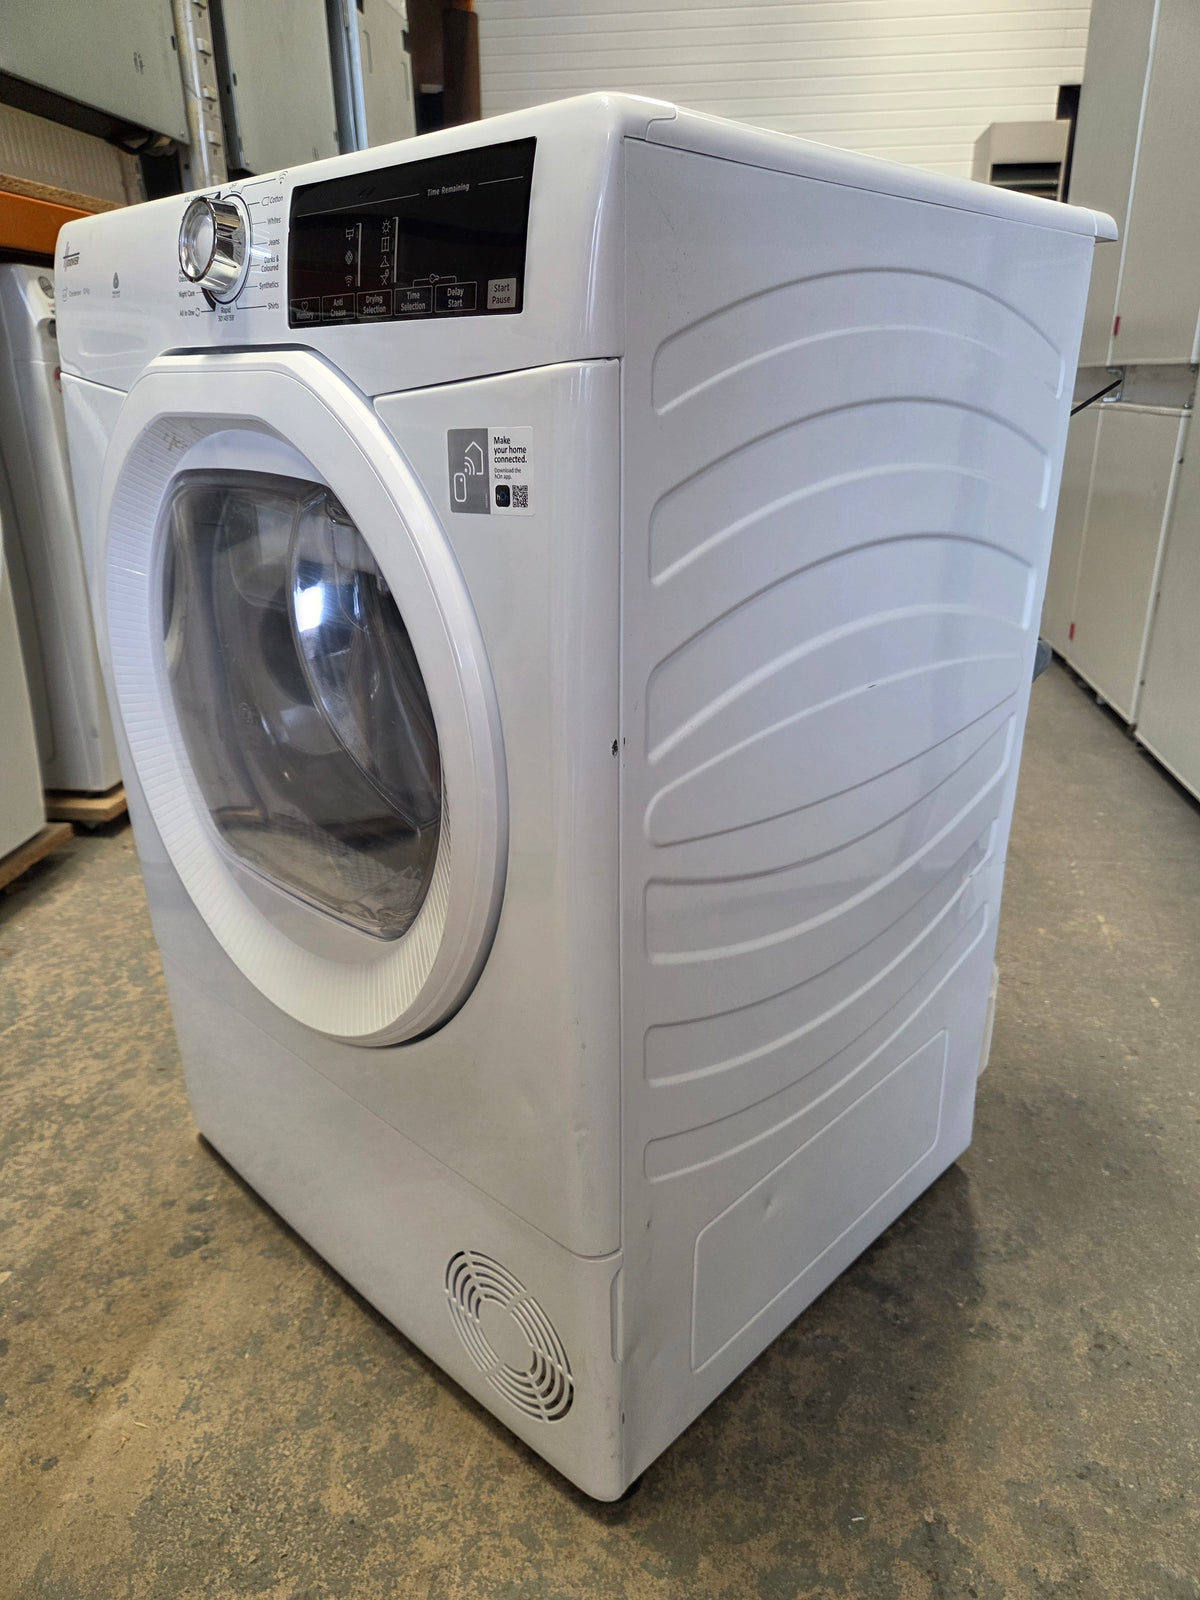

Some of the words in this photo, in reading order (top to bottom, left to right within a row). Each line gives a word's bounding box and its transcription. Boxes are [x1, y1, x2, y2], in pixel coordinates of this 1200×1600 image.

[428, 188, 440, 196] Time
[441, 183, 470, 194] Remaining
[270, 195, 284, 204] Cotton
[264, 255, 275, 264] Darks
[259, 282, 279, 290] Synthetics
[494, 283, 510, 293] Start
[407, 291, 420, 300] Time
[447, 287, 465, 297] Delay
[333, 297, 344, 307] Anti
[365, 294, 383, 305] Drying
[448, 298, 463, 308] Start
[492, 295, 511, 305] Pause
[267, 302, 280, 310] Shirts
[362, 304, 387, 315] Selection
[401, 300, 426, 311] Selection
[330, 308, 346, 317] Crease
[493, 436, 511, 444] Make
[494, 447, 507, 455] your
[508, 446, 527, 454] home
[494, 455, 528, 463] connected.
